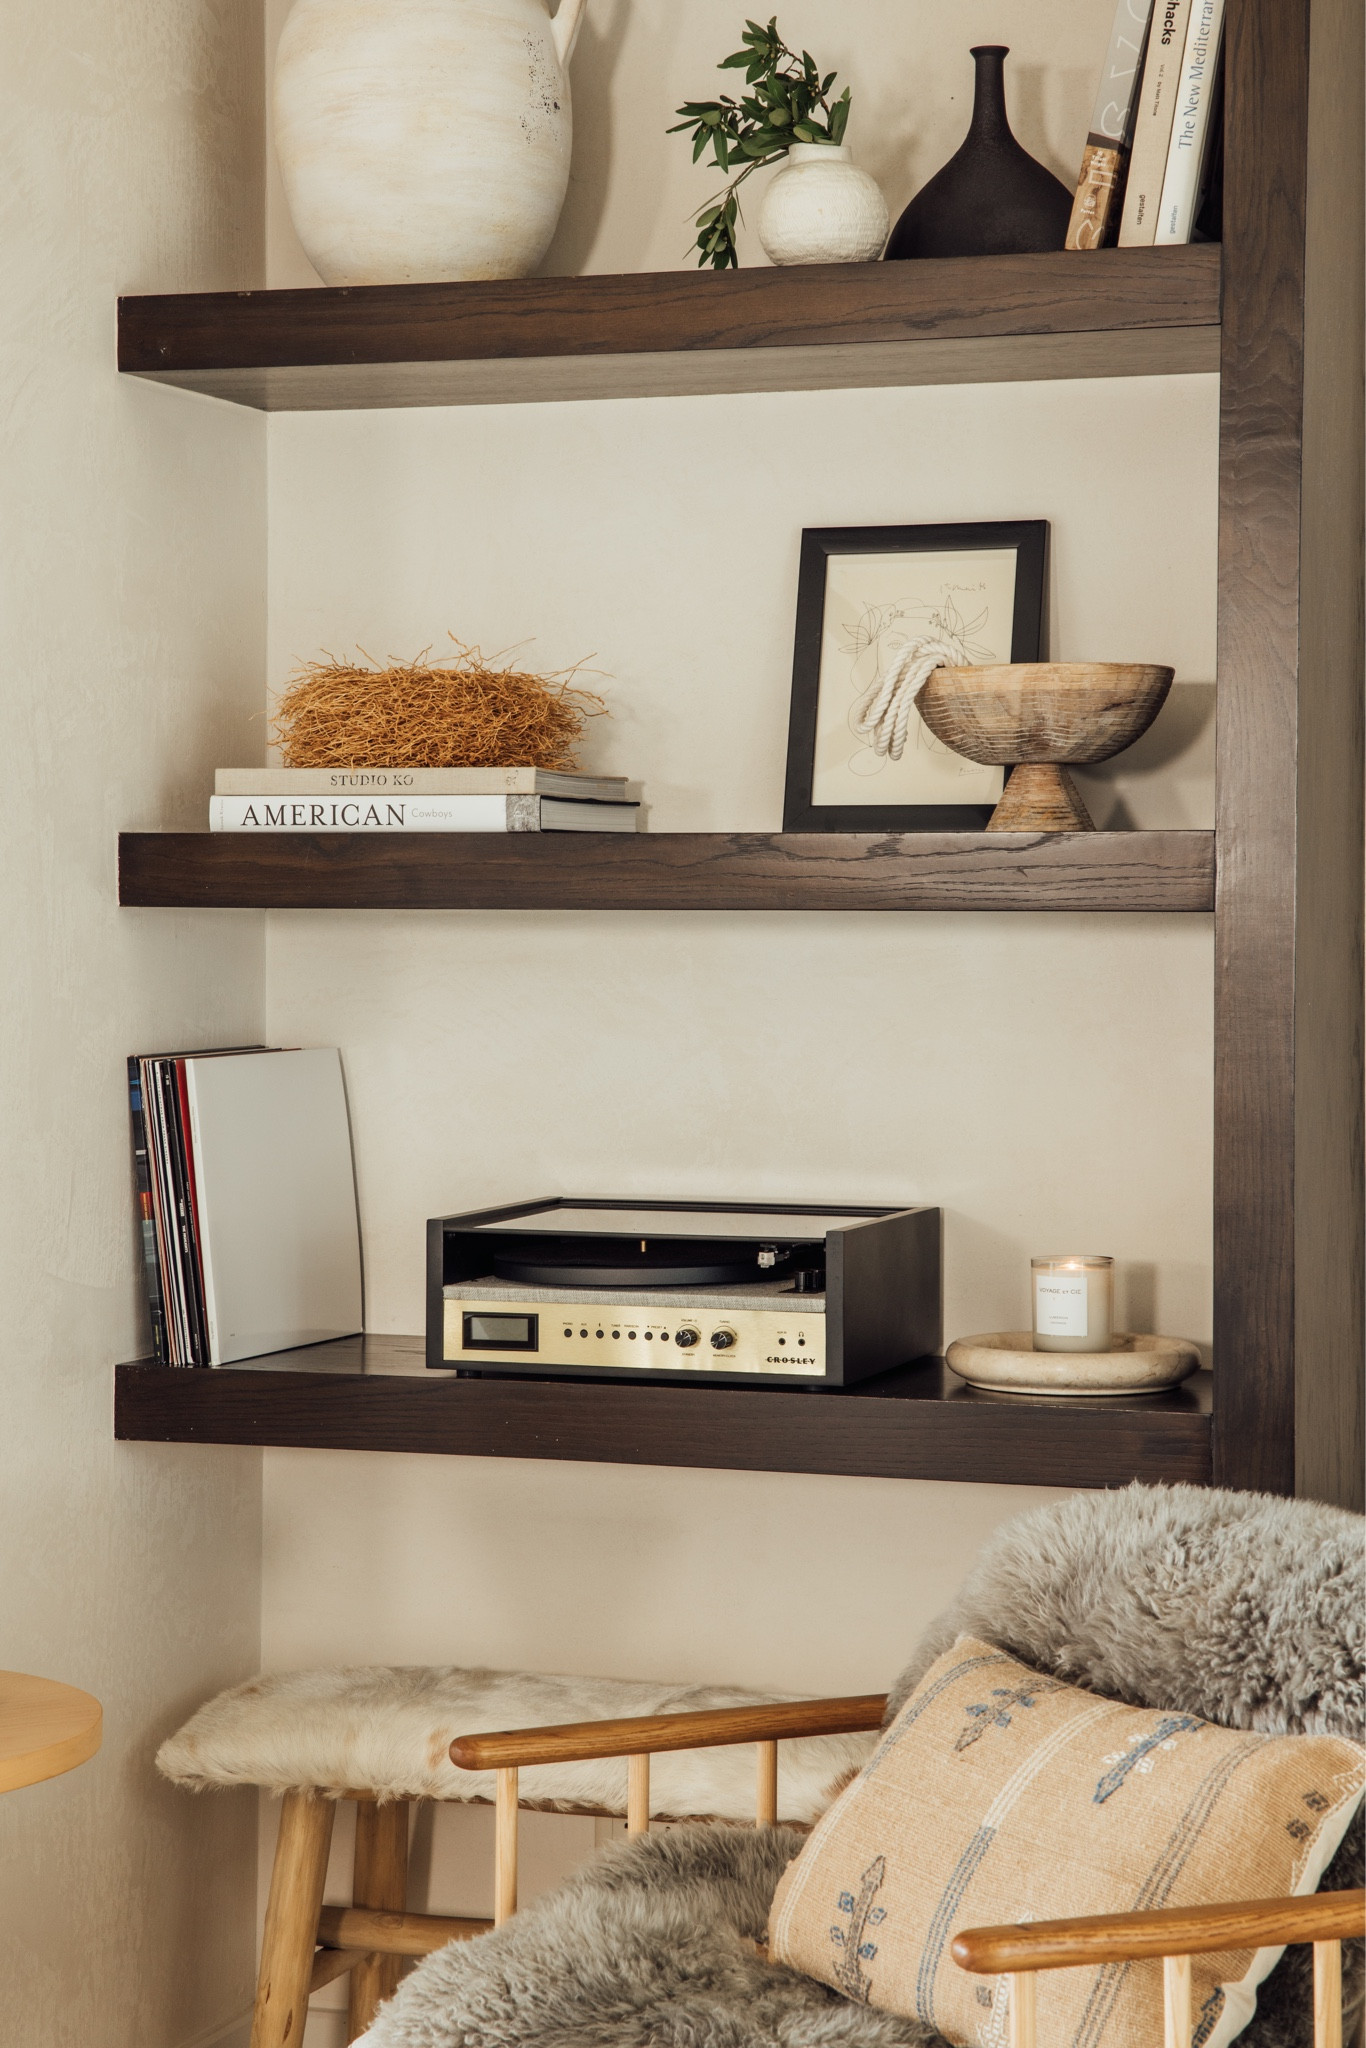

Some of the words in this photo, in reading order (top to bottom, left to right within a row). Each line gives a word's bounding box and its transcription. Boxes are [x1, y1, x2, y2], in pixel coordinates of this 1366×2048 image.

[1160, 0, 1181, 45] hacks
[1183, 84, 1201, 117] New
[1178, 121, 1196, 150] The
[1136, 194, 1146, 226] gestalten
[1169, 205, 1179, 235] gestalten
[330, 774, 388, 787] STUDIO
[392, 774, 414, 787] KO
[240, 803, 407, 827] AMERICAN
[411, 807, 453, 819] Cowboys
[765, 1356, 816, 1365] CROSLEY
